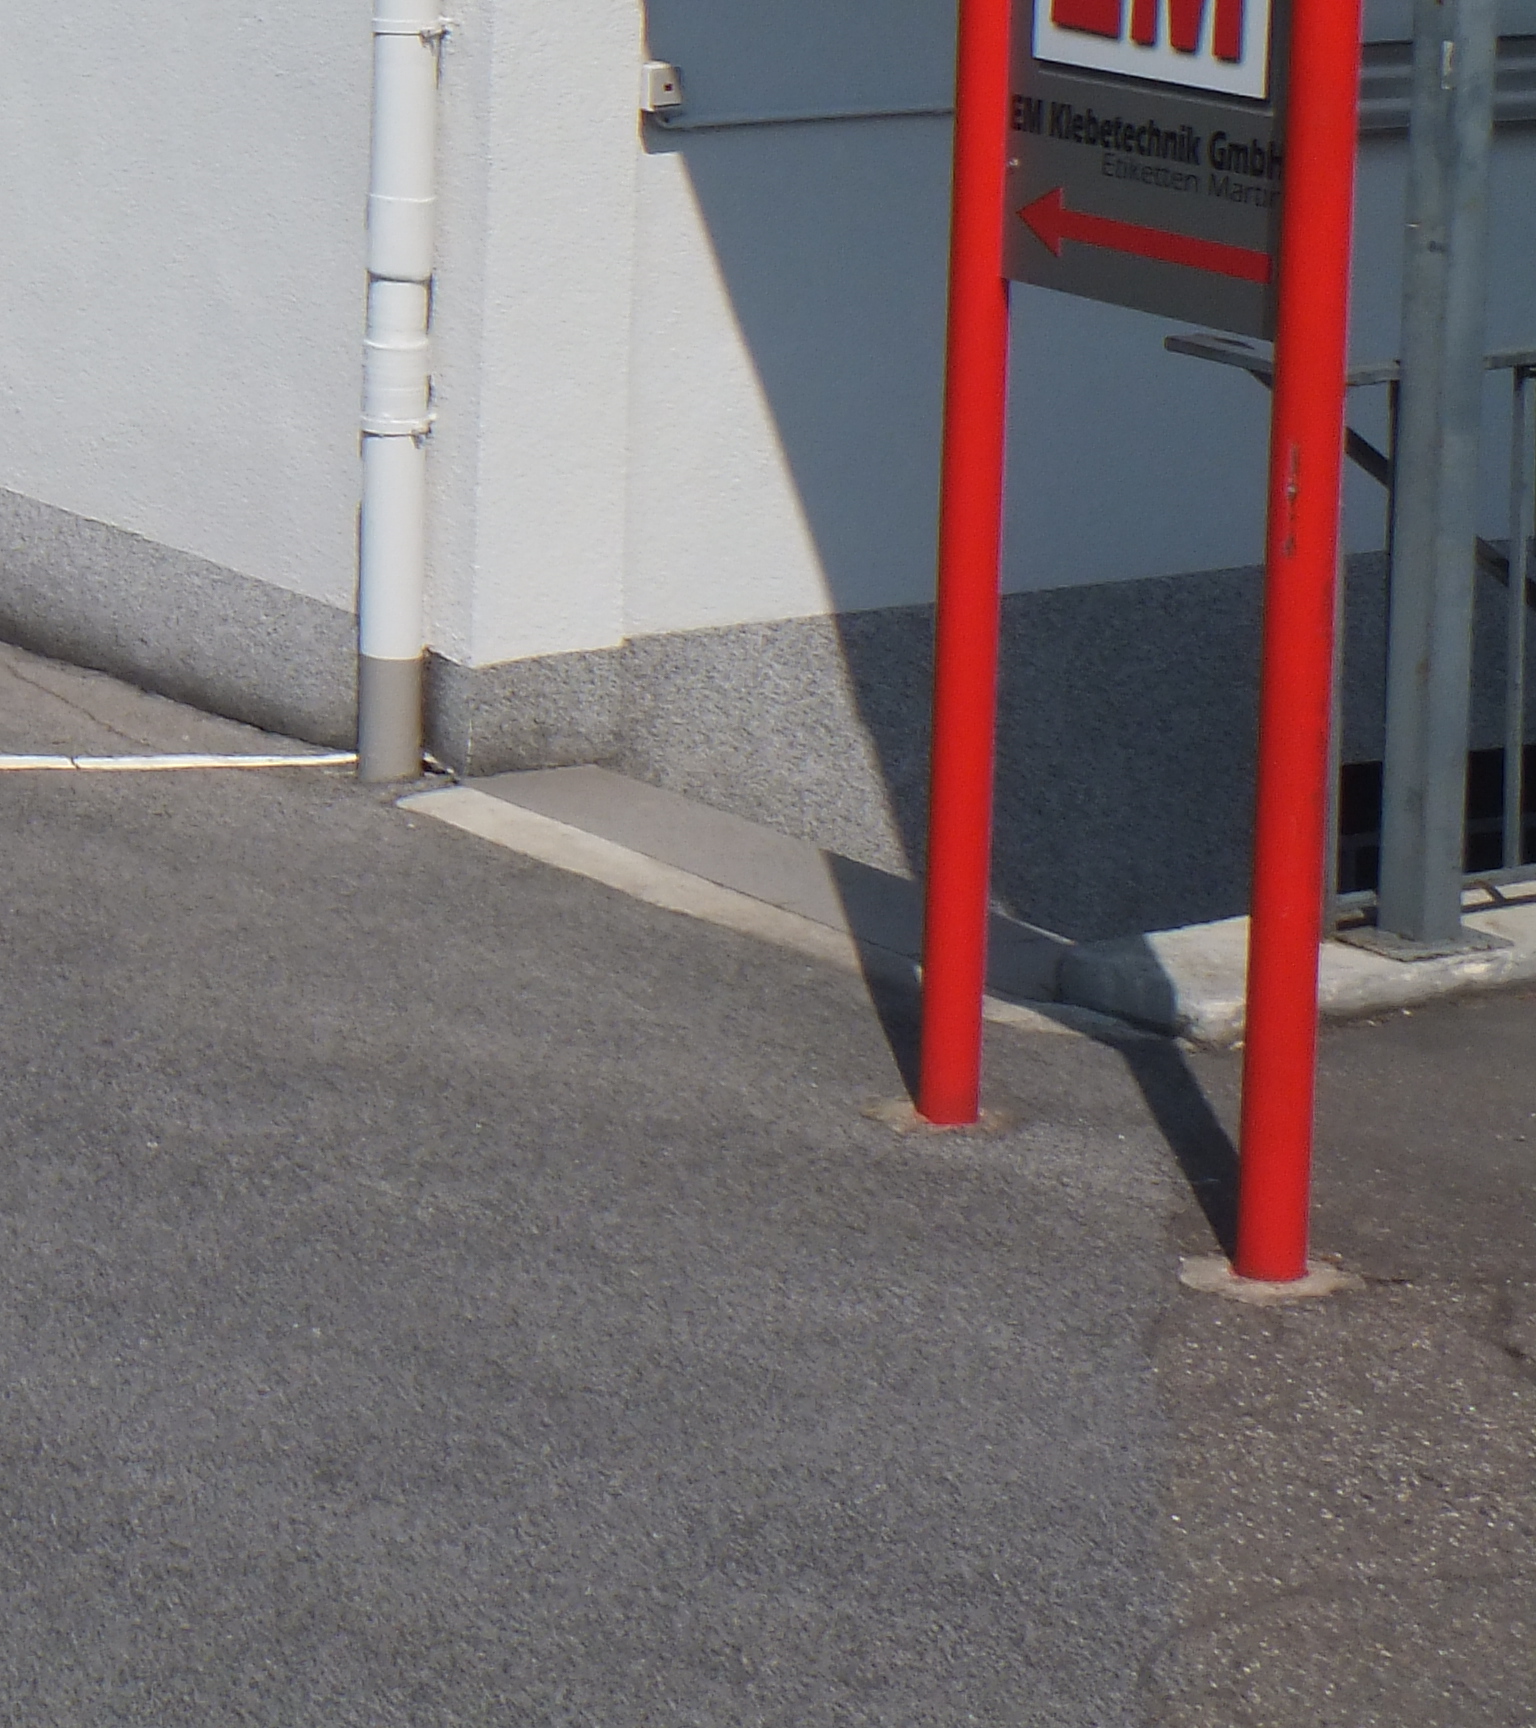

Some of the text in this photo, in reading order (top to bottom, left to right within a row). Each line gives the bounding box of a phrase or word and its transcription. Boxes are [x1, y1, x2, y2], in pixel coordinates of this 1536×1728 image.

[1011, 94, 1284, 181] EM Klebetechnik GmbH
[1101, 152, 1200, 193] Etiketten
